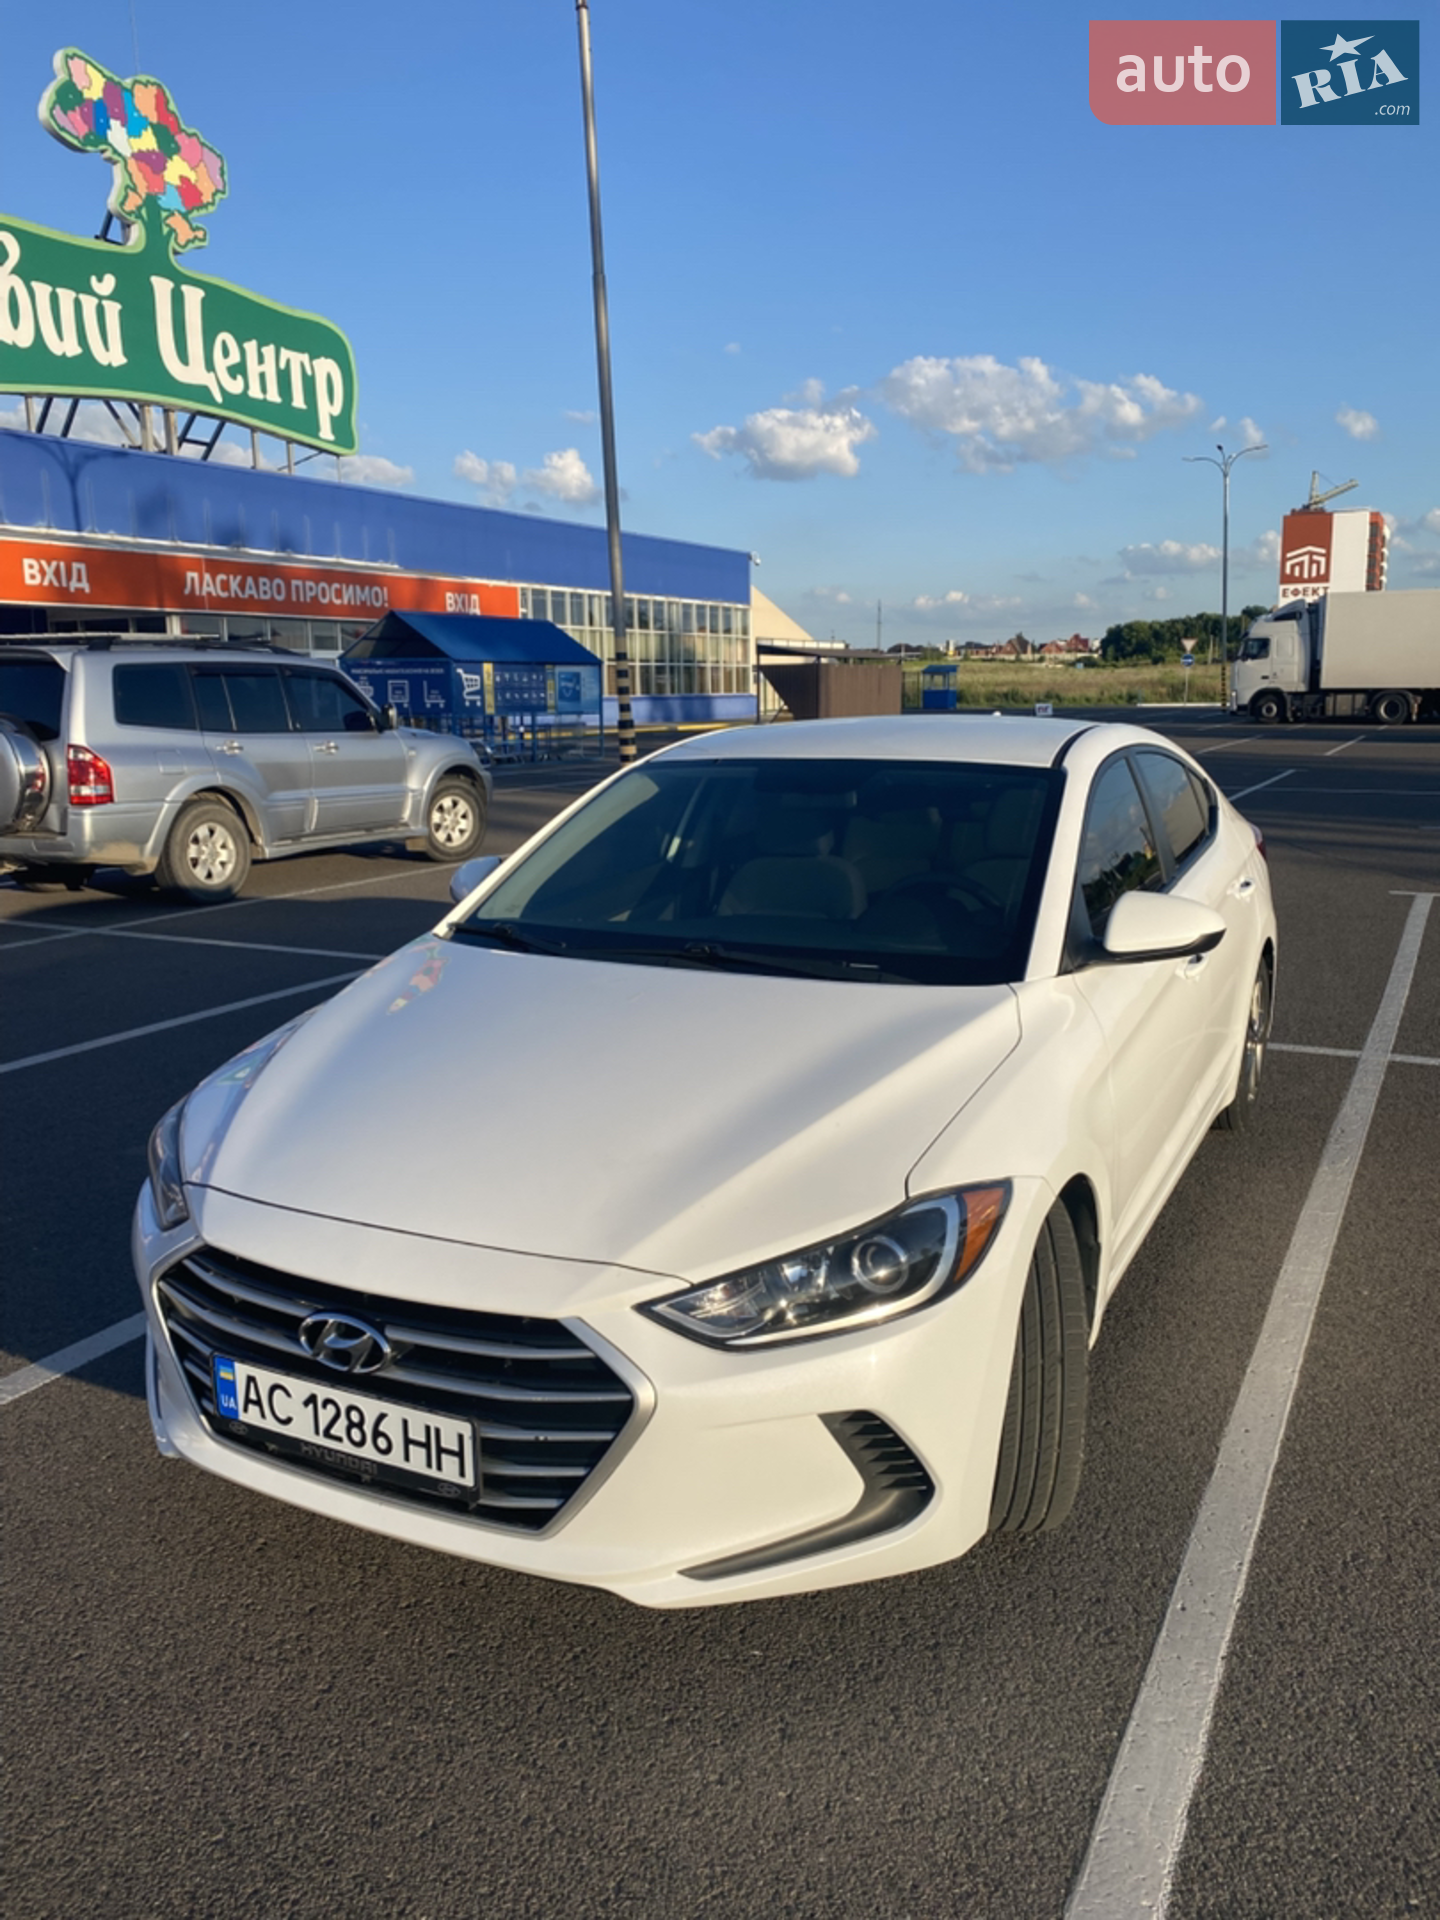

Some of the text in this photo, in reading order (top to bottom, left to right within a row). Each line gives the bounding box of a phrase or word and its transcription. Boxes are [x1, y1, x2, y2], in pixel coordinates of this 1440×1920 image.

[150, 275, 344, 441] Центр
[22, 558, 90, 593] ВХІД
[184, 571, 389, 608] ЛАСКАВО ПРОСИМО!
[445, 591, 481, 616] ВХІД
[221, 1394, 238, 1411] UA
[243, 1374, 466, 1479] AC 1286 HH
